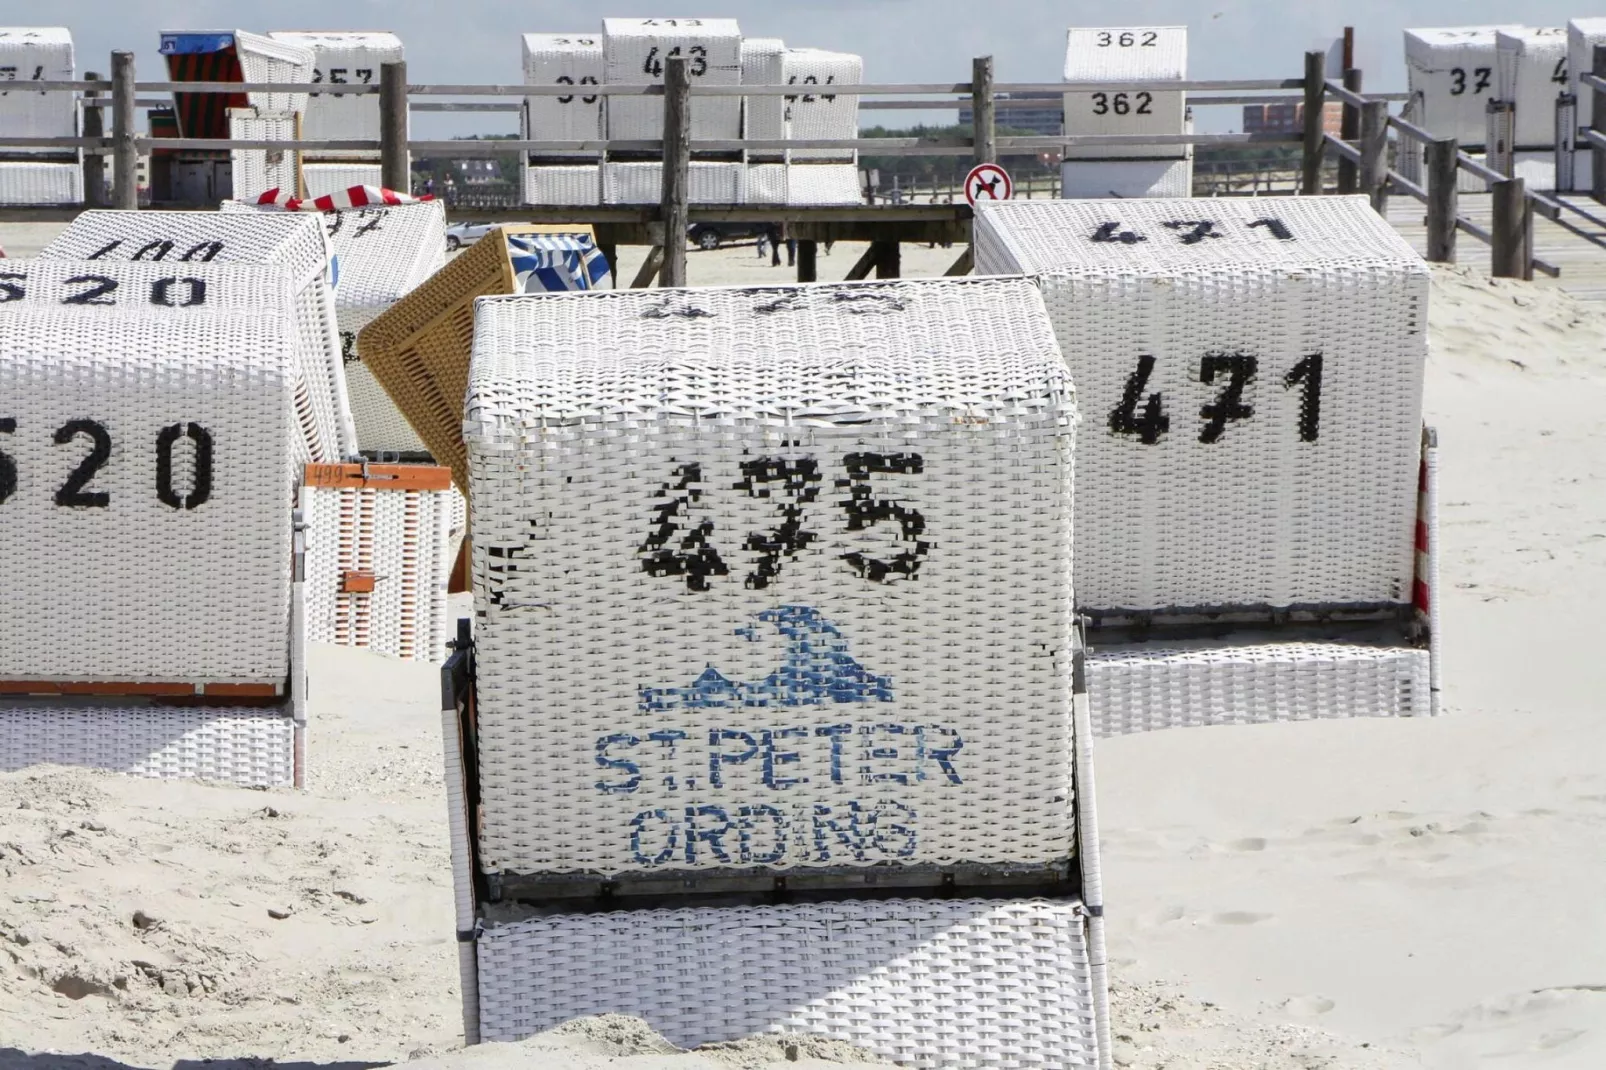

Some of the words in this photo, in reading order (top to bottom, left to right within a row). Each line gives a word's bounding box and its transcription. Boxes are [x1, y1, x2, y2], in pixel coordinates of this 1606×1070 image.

[1097, 31, 1158, 48] 362
[1450, 67, 1493, 95] 37
[1091, 91, 1153, 115] 362
[1090, 219, 1298, 245] 471
[1107, 352, 1325, 445] 471
[638, 452, 939, 592] 475
